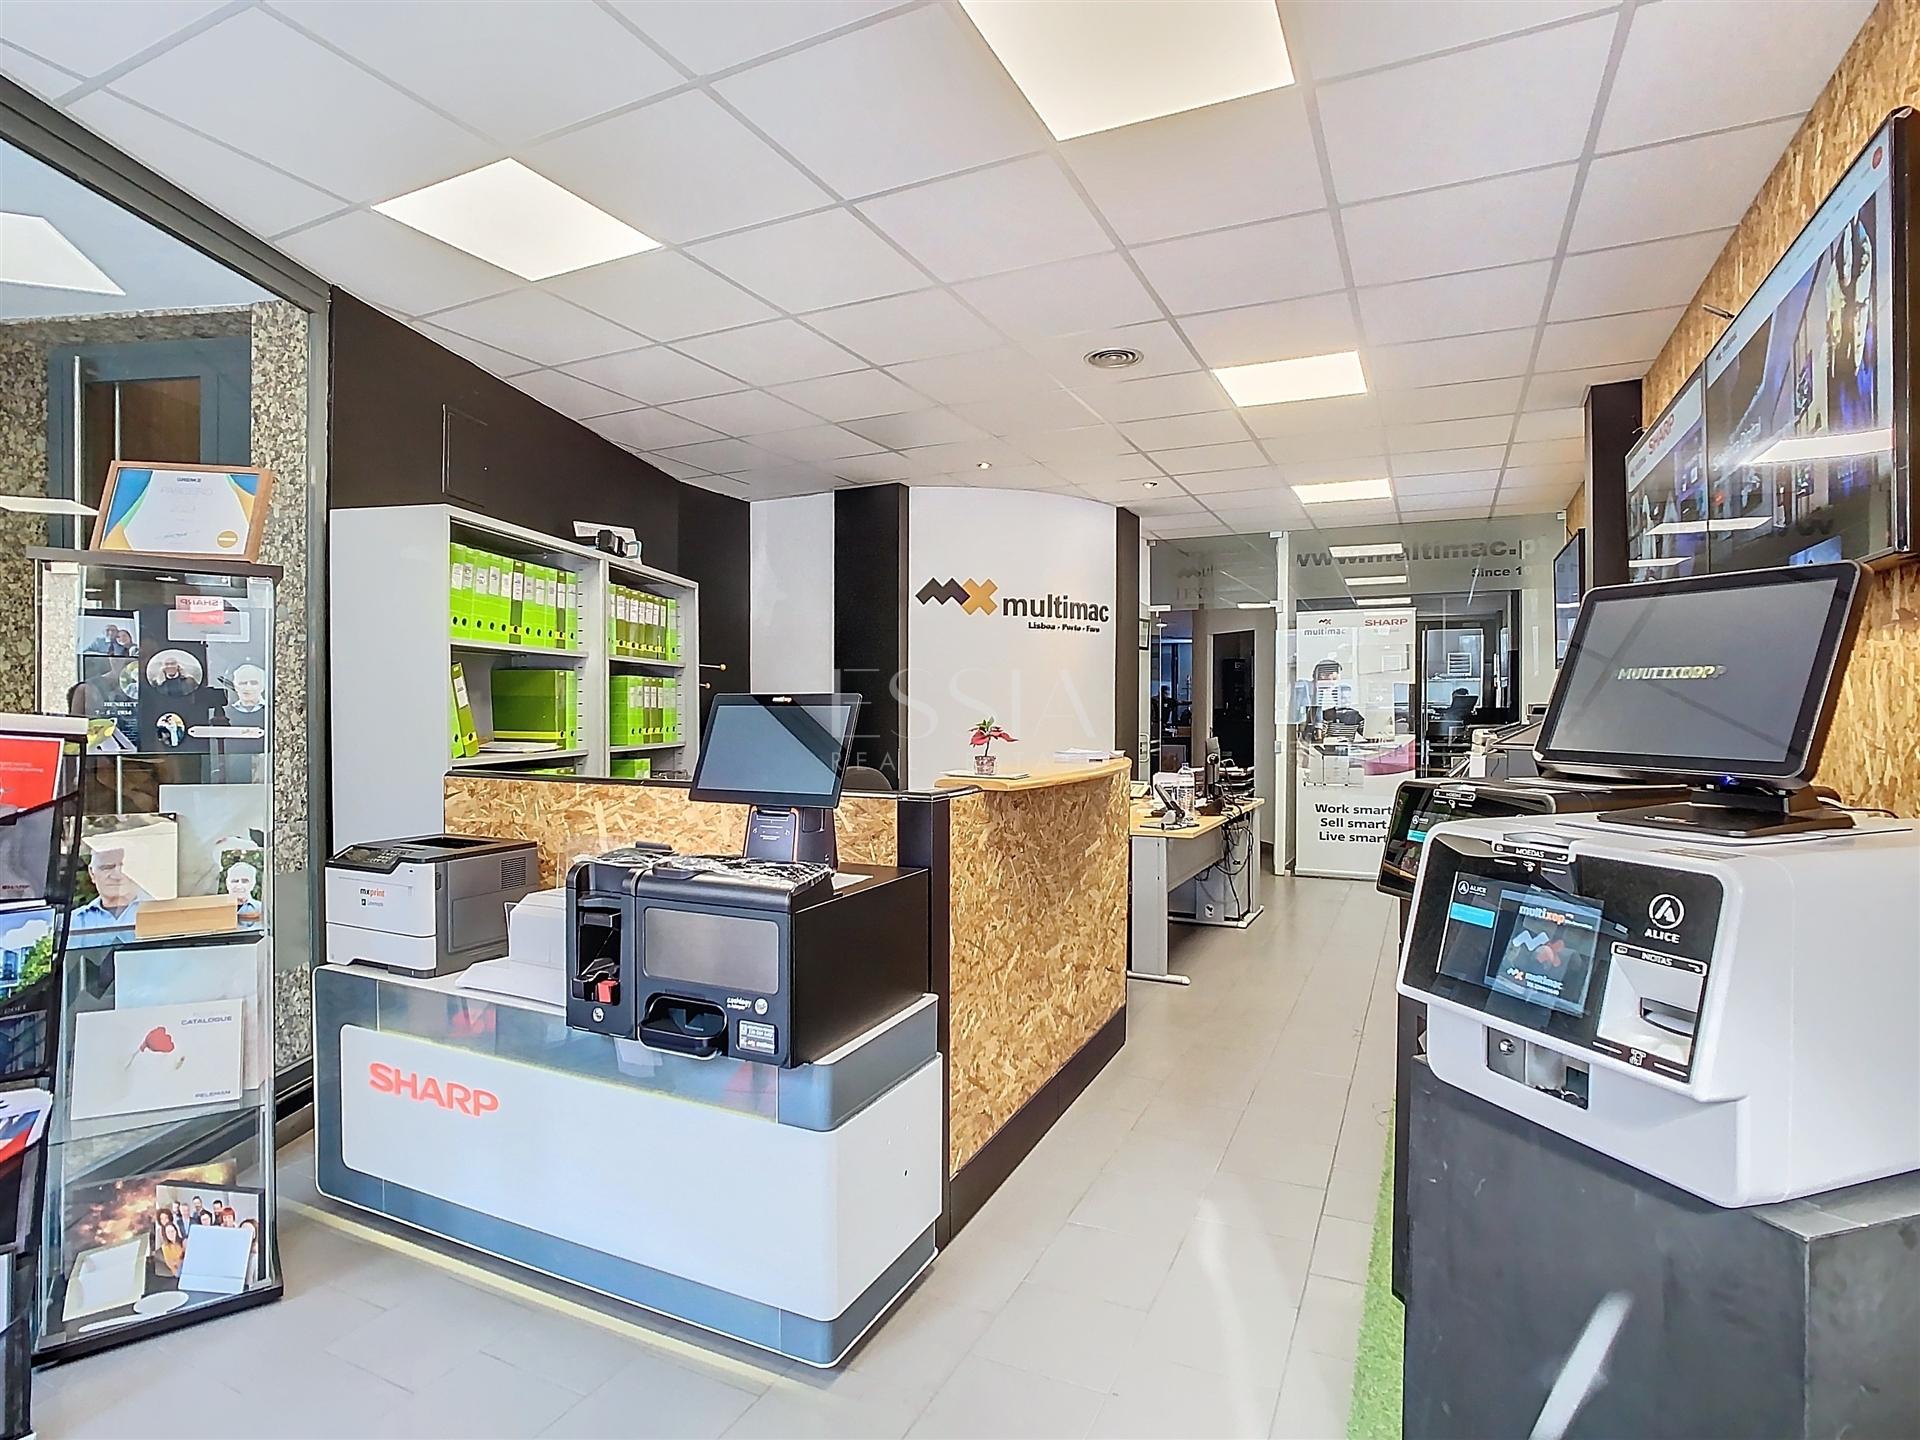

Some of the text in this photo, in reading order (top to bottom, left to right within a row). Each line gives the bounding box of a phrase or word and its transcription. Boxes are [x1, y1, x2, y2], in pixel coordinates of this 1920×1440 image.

[1472, 567, 1511, 577] Since
[1002, 594, 1109, 622] multimac
[1028, 621, 1056, 630] Lisboa
[1364, 618, 1409, 627] SHARP
[1315, 804, 1350, 814] Work
[1320, 817, 1344, 828] Sell
[1319, 831, 1346, 841] Live
[1515, 847, 1545, 858] MOEDAS
[1644, 928, 1681, 944] ALICE
[181, 1015, 233, 1026] CATALOGUE
[369, 1062, 499, 1117] SHARP
